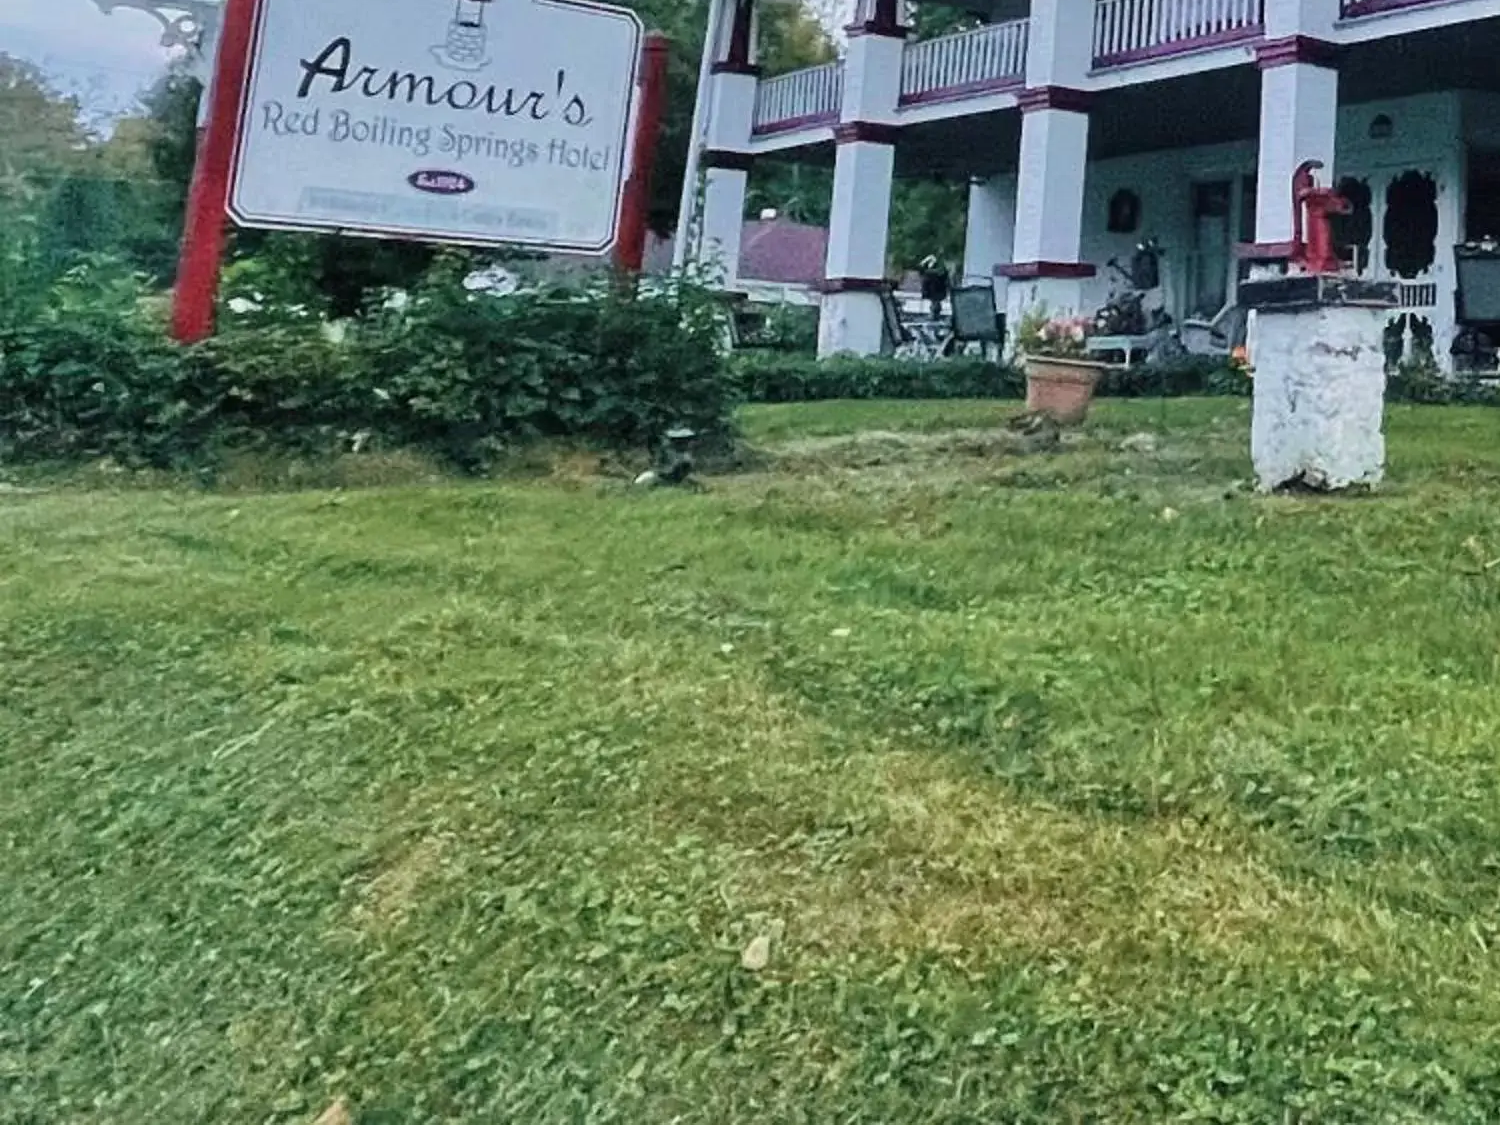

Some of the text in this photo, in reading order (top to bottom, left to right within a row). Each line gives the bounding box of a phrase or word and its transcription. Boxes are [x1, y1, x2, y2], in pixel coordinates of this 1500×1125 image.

[297, 36, 593, 127] Armour's
[263, 101, 611, 172] Red Boiling Springs Hotel
